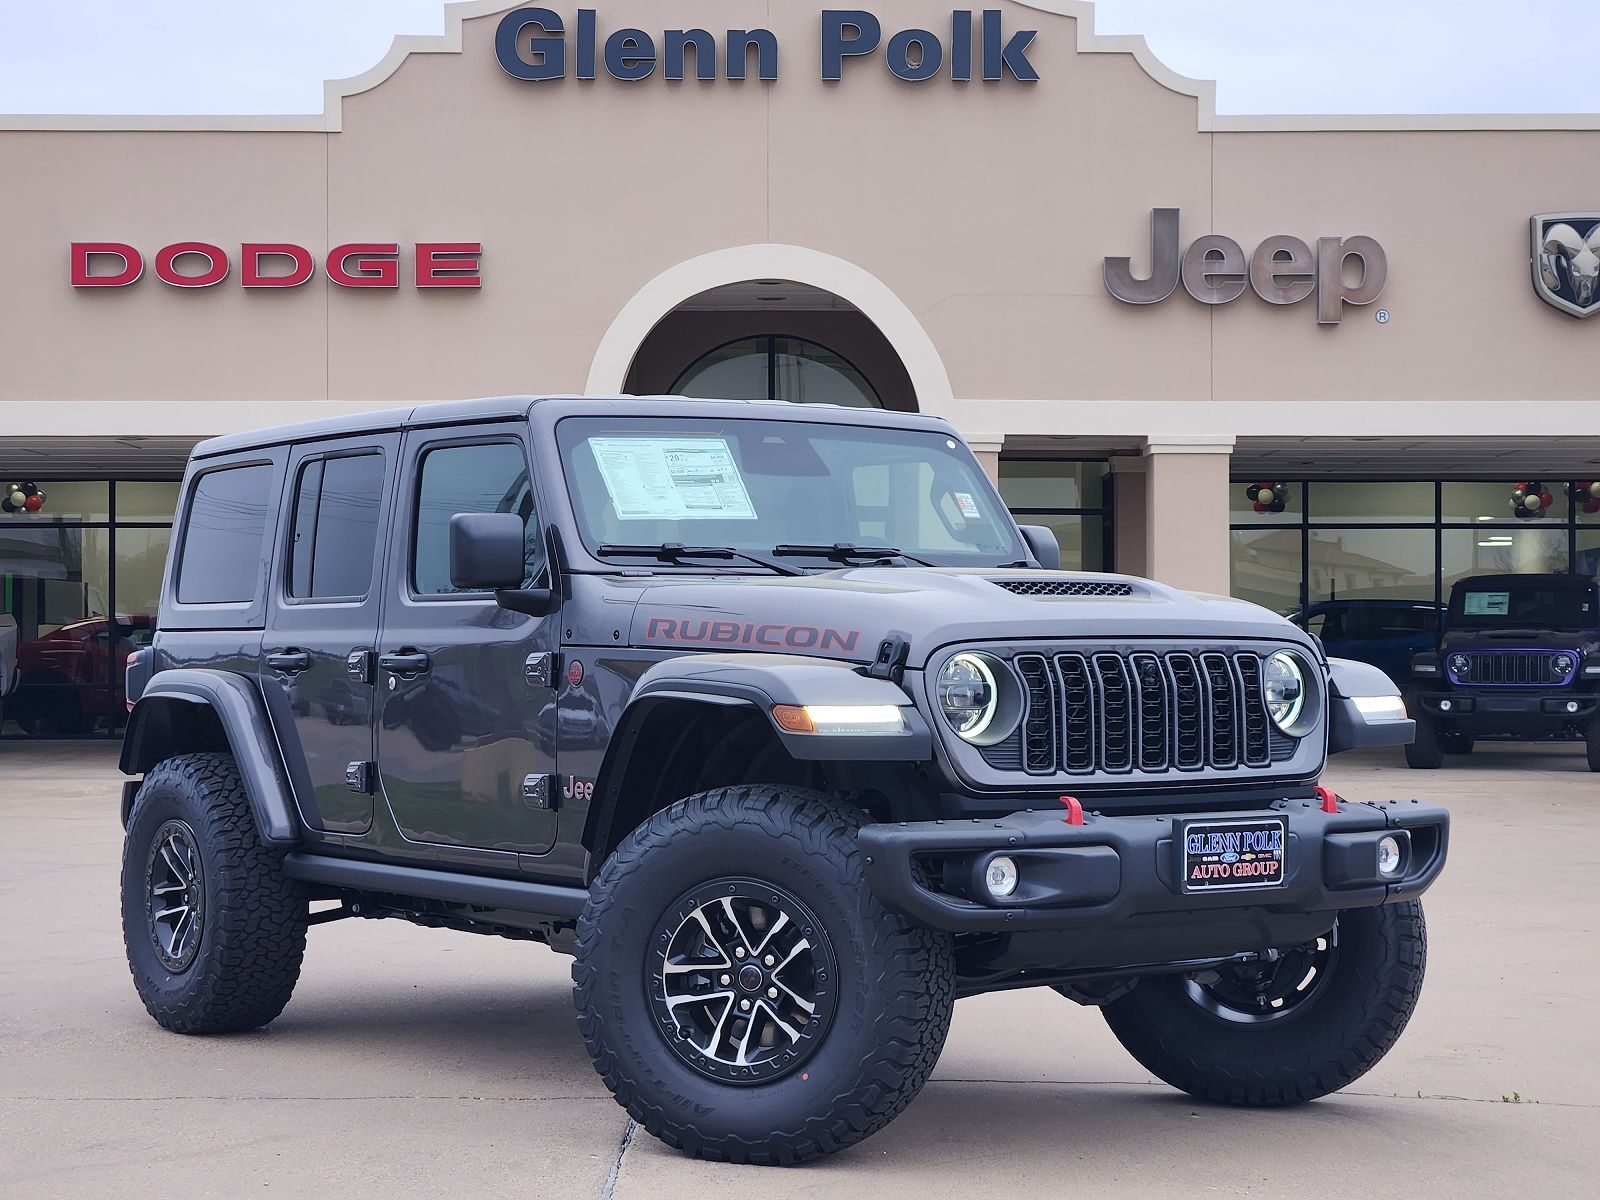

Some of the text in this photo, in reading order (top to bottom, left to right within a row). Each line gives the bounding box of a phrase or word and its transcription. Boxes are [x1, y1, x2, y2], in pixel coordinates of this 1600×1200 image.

[495, 7, 1040, 82] Glenn Polk
[70, 242, 482, 288] DODGE
[1103, 207, 1388, 325] Jeep
[647, 617, 861, 652] RUBICON
[563, 775, 594, 800] Jee
[1187, 830, 1282, 854] GLENN POLK
[1191, 861, 1278, 879] AUTO GROUP
